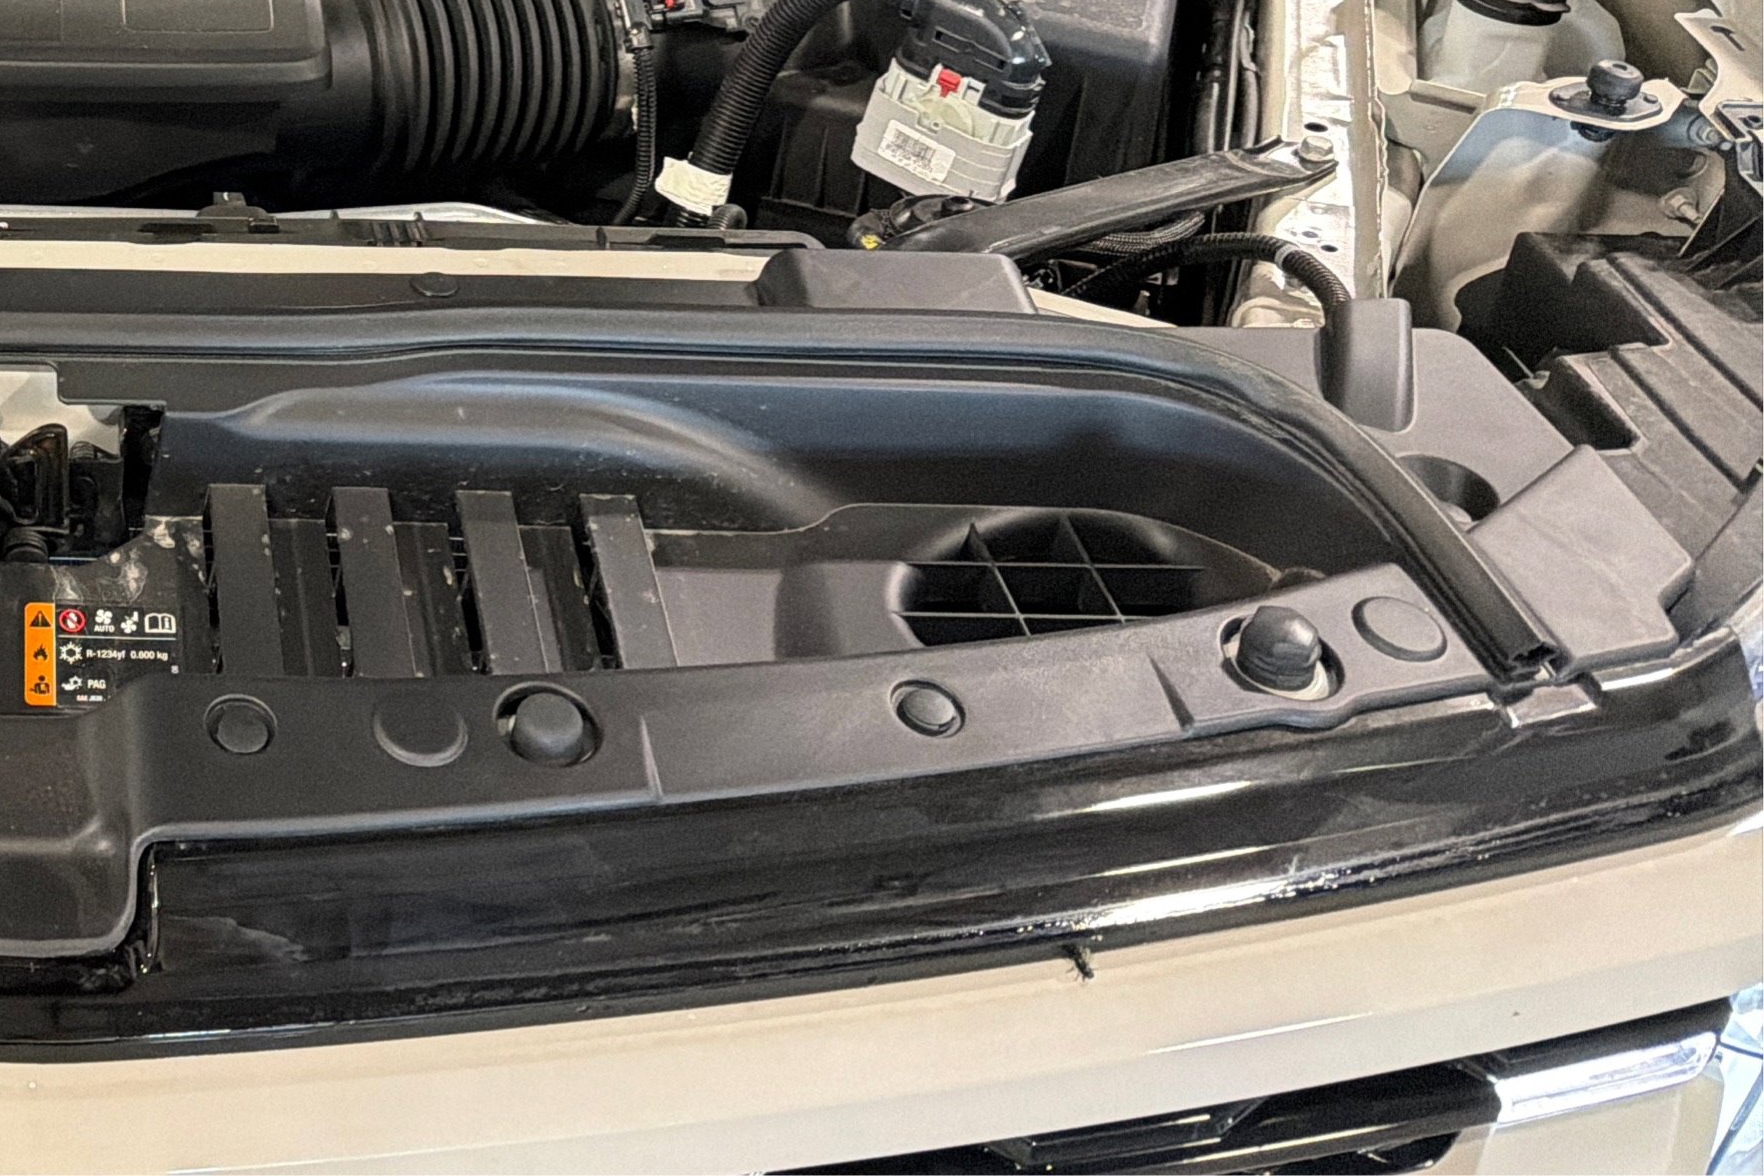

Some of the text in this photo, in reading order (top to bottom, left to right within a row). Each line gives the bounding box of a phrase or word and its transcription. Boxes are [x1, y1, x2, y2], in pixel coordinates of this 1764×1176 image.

[94, 625, 115, 633] AUTO
[86, 649, 126, 661] R-1234yf
[156, 650, 168, 661] kg
[87, 679, 106, 689] PAG
